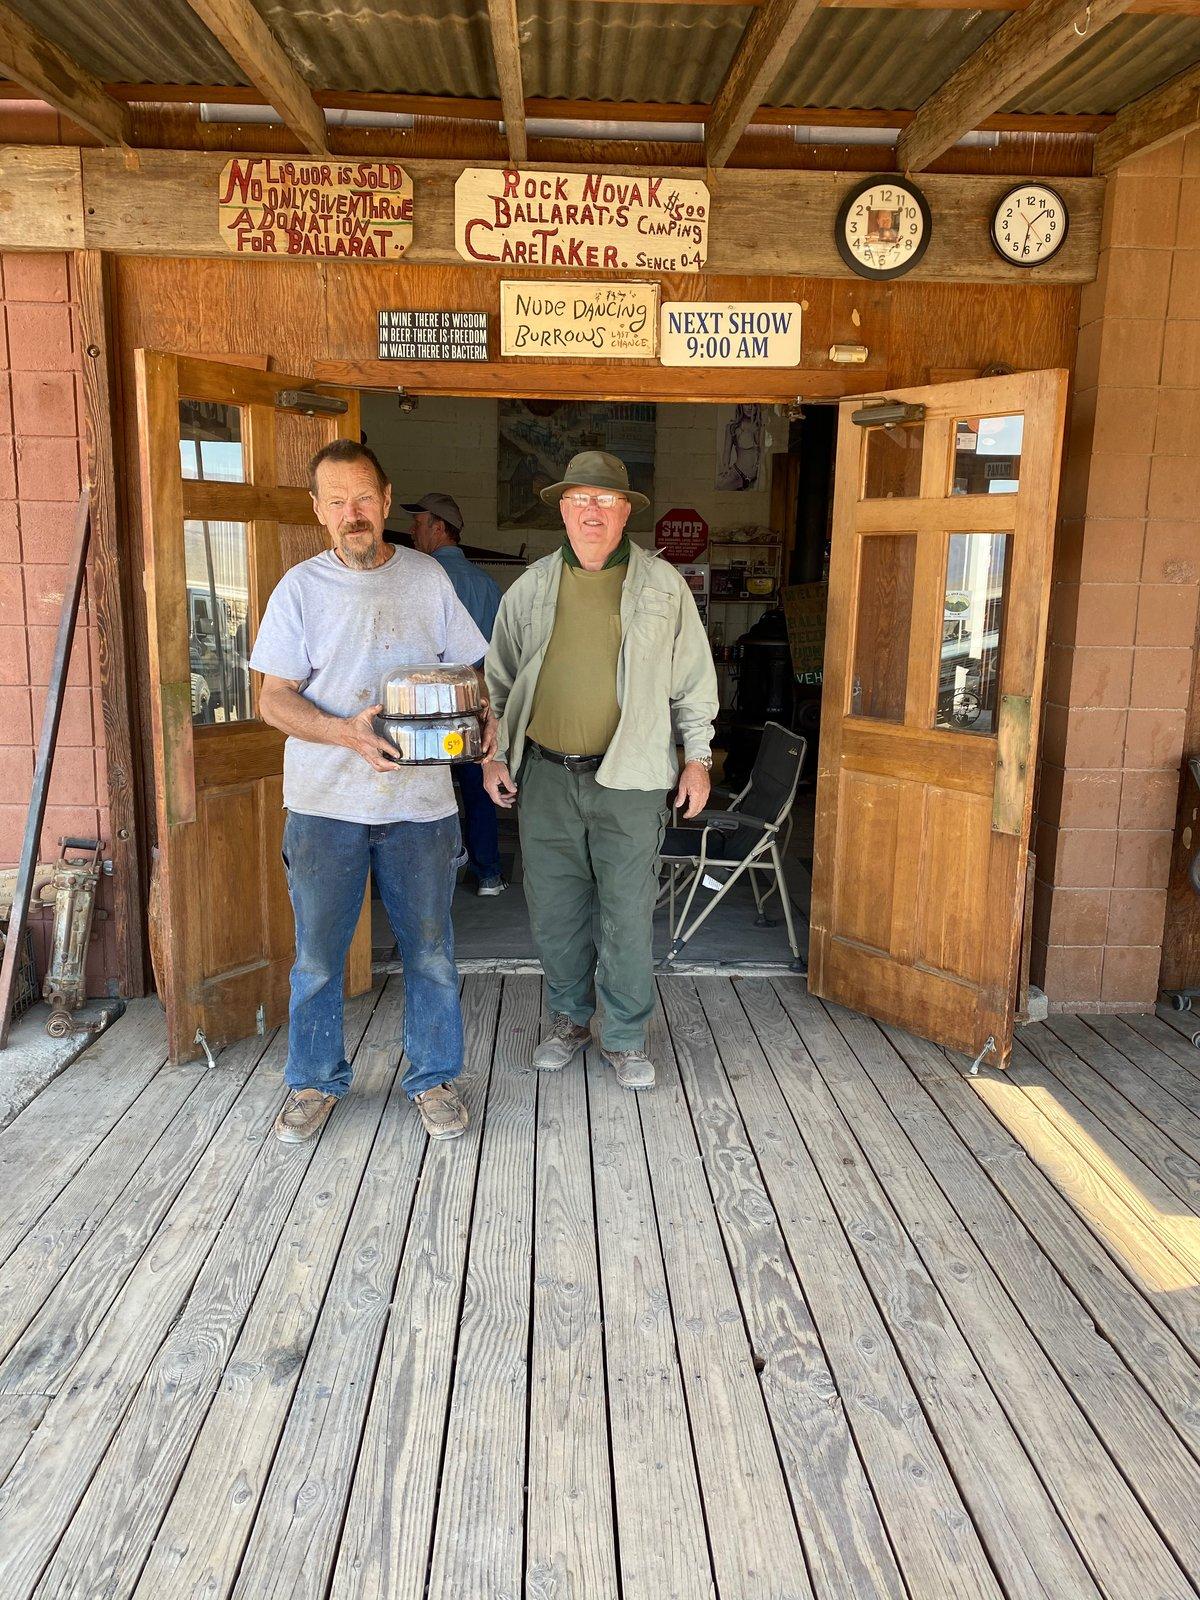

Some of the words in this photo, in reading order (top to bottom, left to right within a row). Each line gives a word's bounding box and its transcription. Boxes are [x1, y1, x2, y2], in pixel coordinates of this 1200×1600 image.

[502, 169, 567, 201] ROCK
[582, 174, 663, 208] NOVAK
[268, 187, 307, 210] ONLY
[869, 194, 872, 206] 1
[880, 190, 892, 202] 12
[895, 194, 904, 206] 11
[1026, 196, 1035, 206] 12
[1038, 199, 1045, 209] 11
[855, 205, 863, 216] 2
[905, 207, 916, 219] 10
[1006, 208, 1012, 218] 2
[1046, 208, 1054, 218] 10
[227, 208, 254, 229] A
[850, 222, 857, 233] 3
[909, 223, 917, 234] 9
[1002, 220, 1008, 229] 3
[1049, 221, 1055, 231] 9
[237, 228, 276, 253] FOR
[1004, 233, 1010, 242] 4
[1045, 233, 1050, 243] 8
[852, 238, 860, 249] 4
[904, 239, 911, 250] 8
[1012, 242, 1018, 252] 5
[1036, 242, 1042, 252] 7
[1024, 245, 1029, 255] 6
[635, 251, 675, 271] SENCE
[878, 254, 885, 266] 6
[379, 311, 387, 326] IN
[390, 312, 411, 327] WINE
[414, 312, 438, 327] THERE
[441, 313, 448, 327] IS
[452, 313, 486, 328] WISDOM
[668, 312, 723, 334] NEXT
[728, 312, 792, 335] SHOW
[379, 327, 387, 342] IN
[611, 331, 630, 339] LAST
[379, 343, 387, 357] IN
[389, 343, 415, 358] WATER
[417, 344, 439, 358] THERE
[442, 345, 448, 358] IS
[451, 345, 487, 360] BACTERIA
[686, 336, 730, 358] 9:00
[736, 336, 768, 358] AM
[661, 520, 702, 538] STOP
